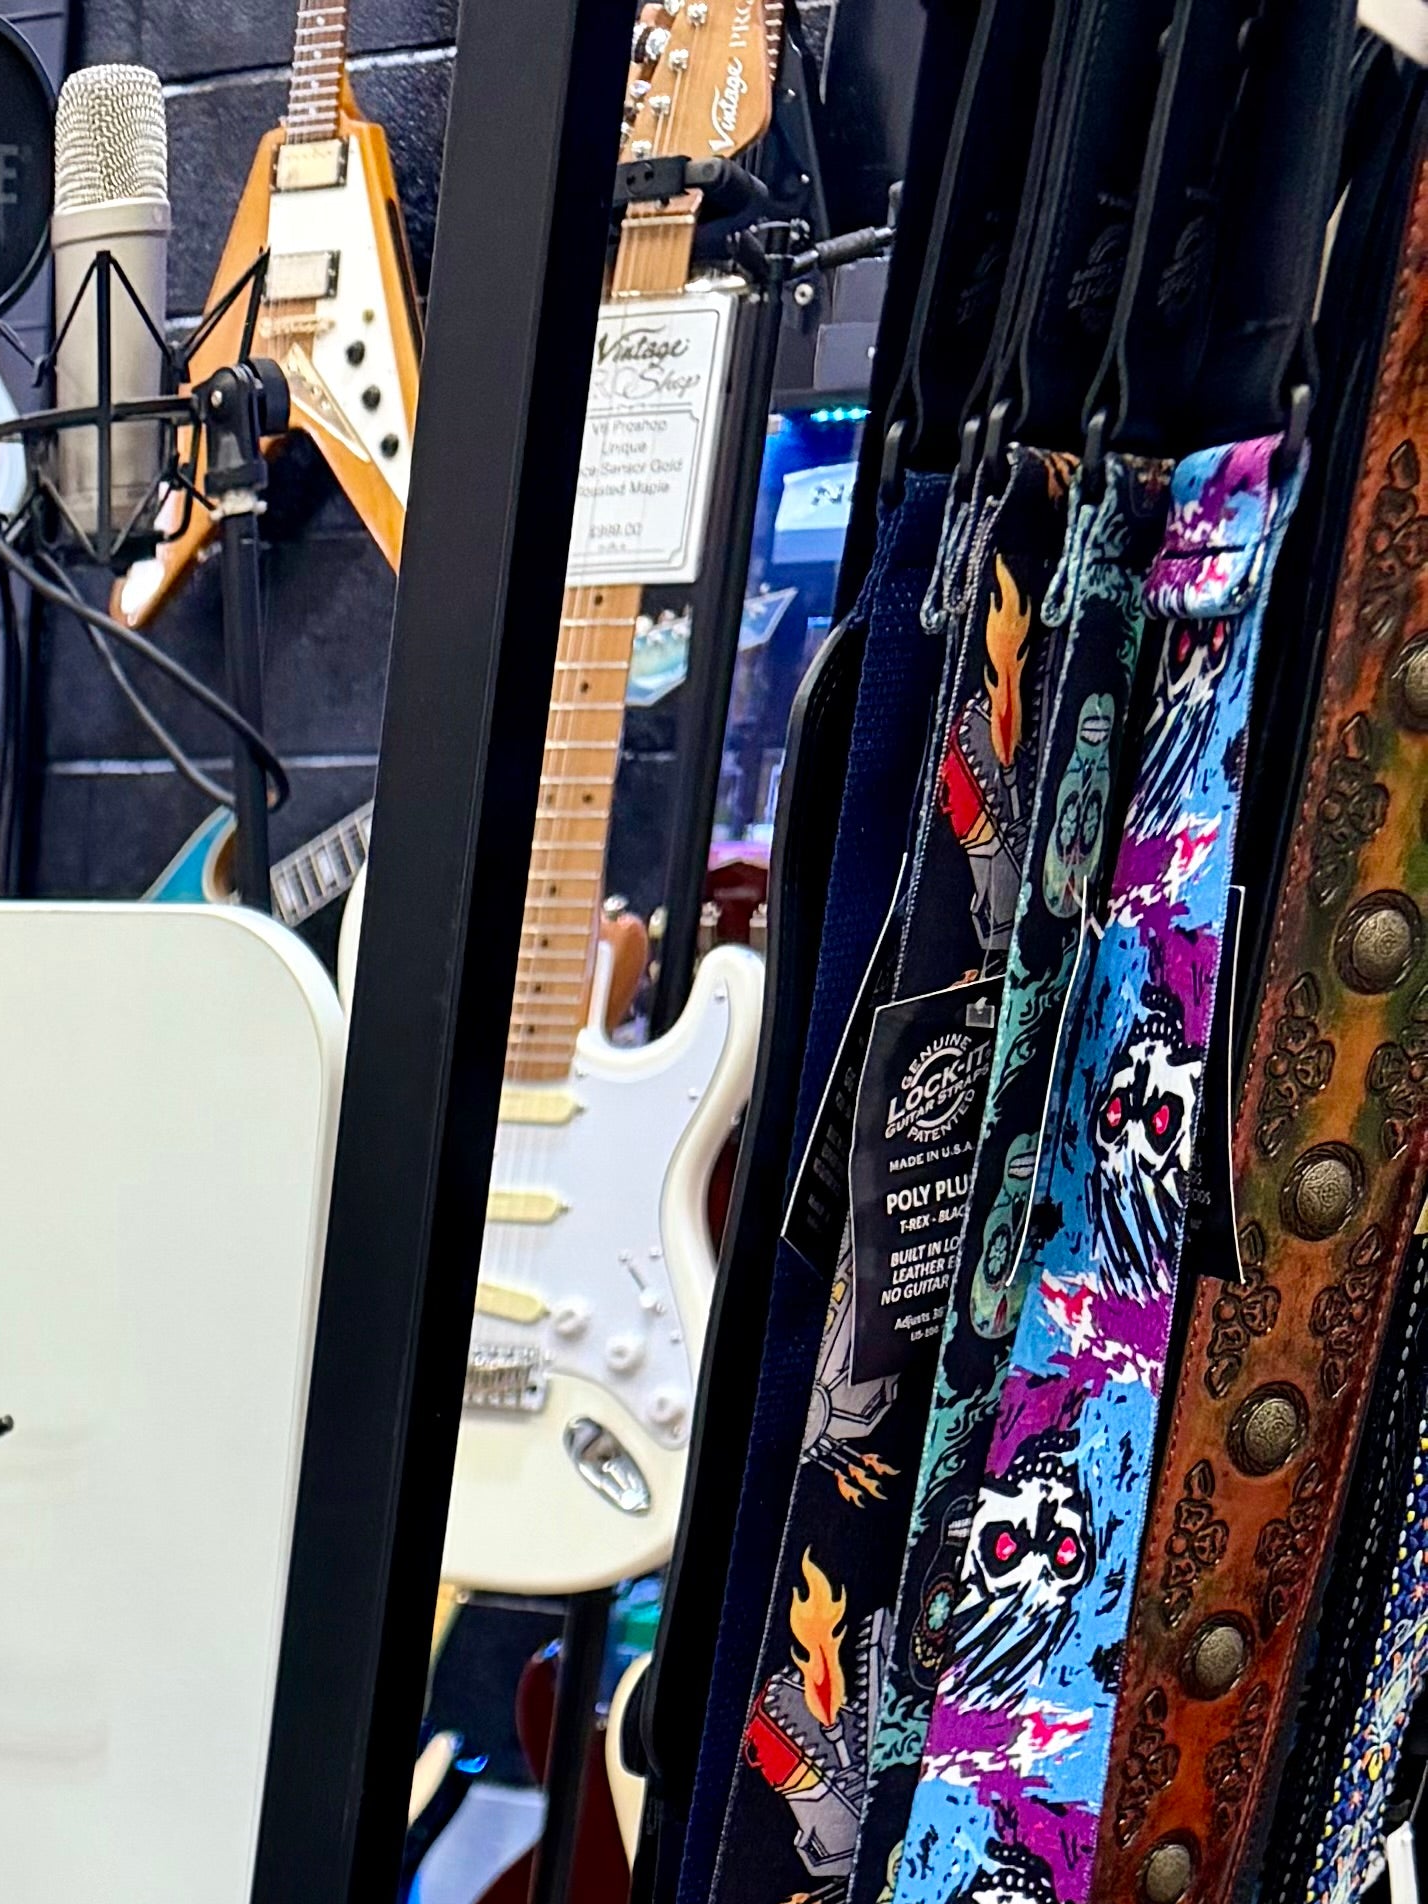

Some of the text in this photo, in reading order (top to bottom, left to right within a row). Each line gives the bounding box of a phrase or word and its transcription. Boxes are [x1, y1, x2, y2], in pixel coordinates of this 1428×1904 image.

[708, 56, 748, 152] Vintage
[596, 325, 690, 368] Vintage
[887, 1040, 991, 1125] LOCK-IT
[901, 1033, 972, 1090] GENUINE
[885, 1062, 990, 1139] GUITAR STRAPS
[907, 1088, 976, 1143] PATENTED
[889, 1153, 924, 1173] MADE
[926, 1148, 940, 1162] IN
[886, 1173, 972, 1215] POLY PLU
[900, 1204, 967, 1234] T-REX BLAC
[890, 1247, 926, 1268] BUILT
[928, 1242, 942, 1257] IN
[892, 1259, 946, 1285] LEATHER
[880, 1273, 950, 1306] NO GUITAR
